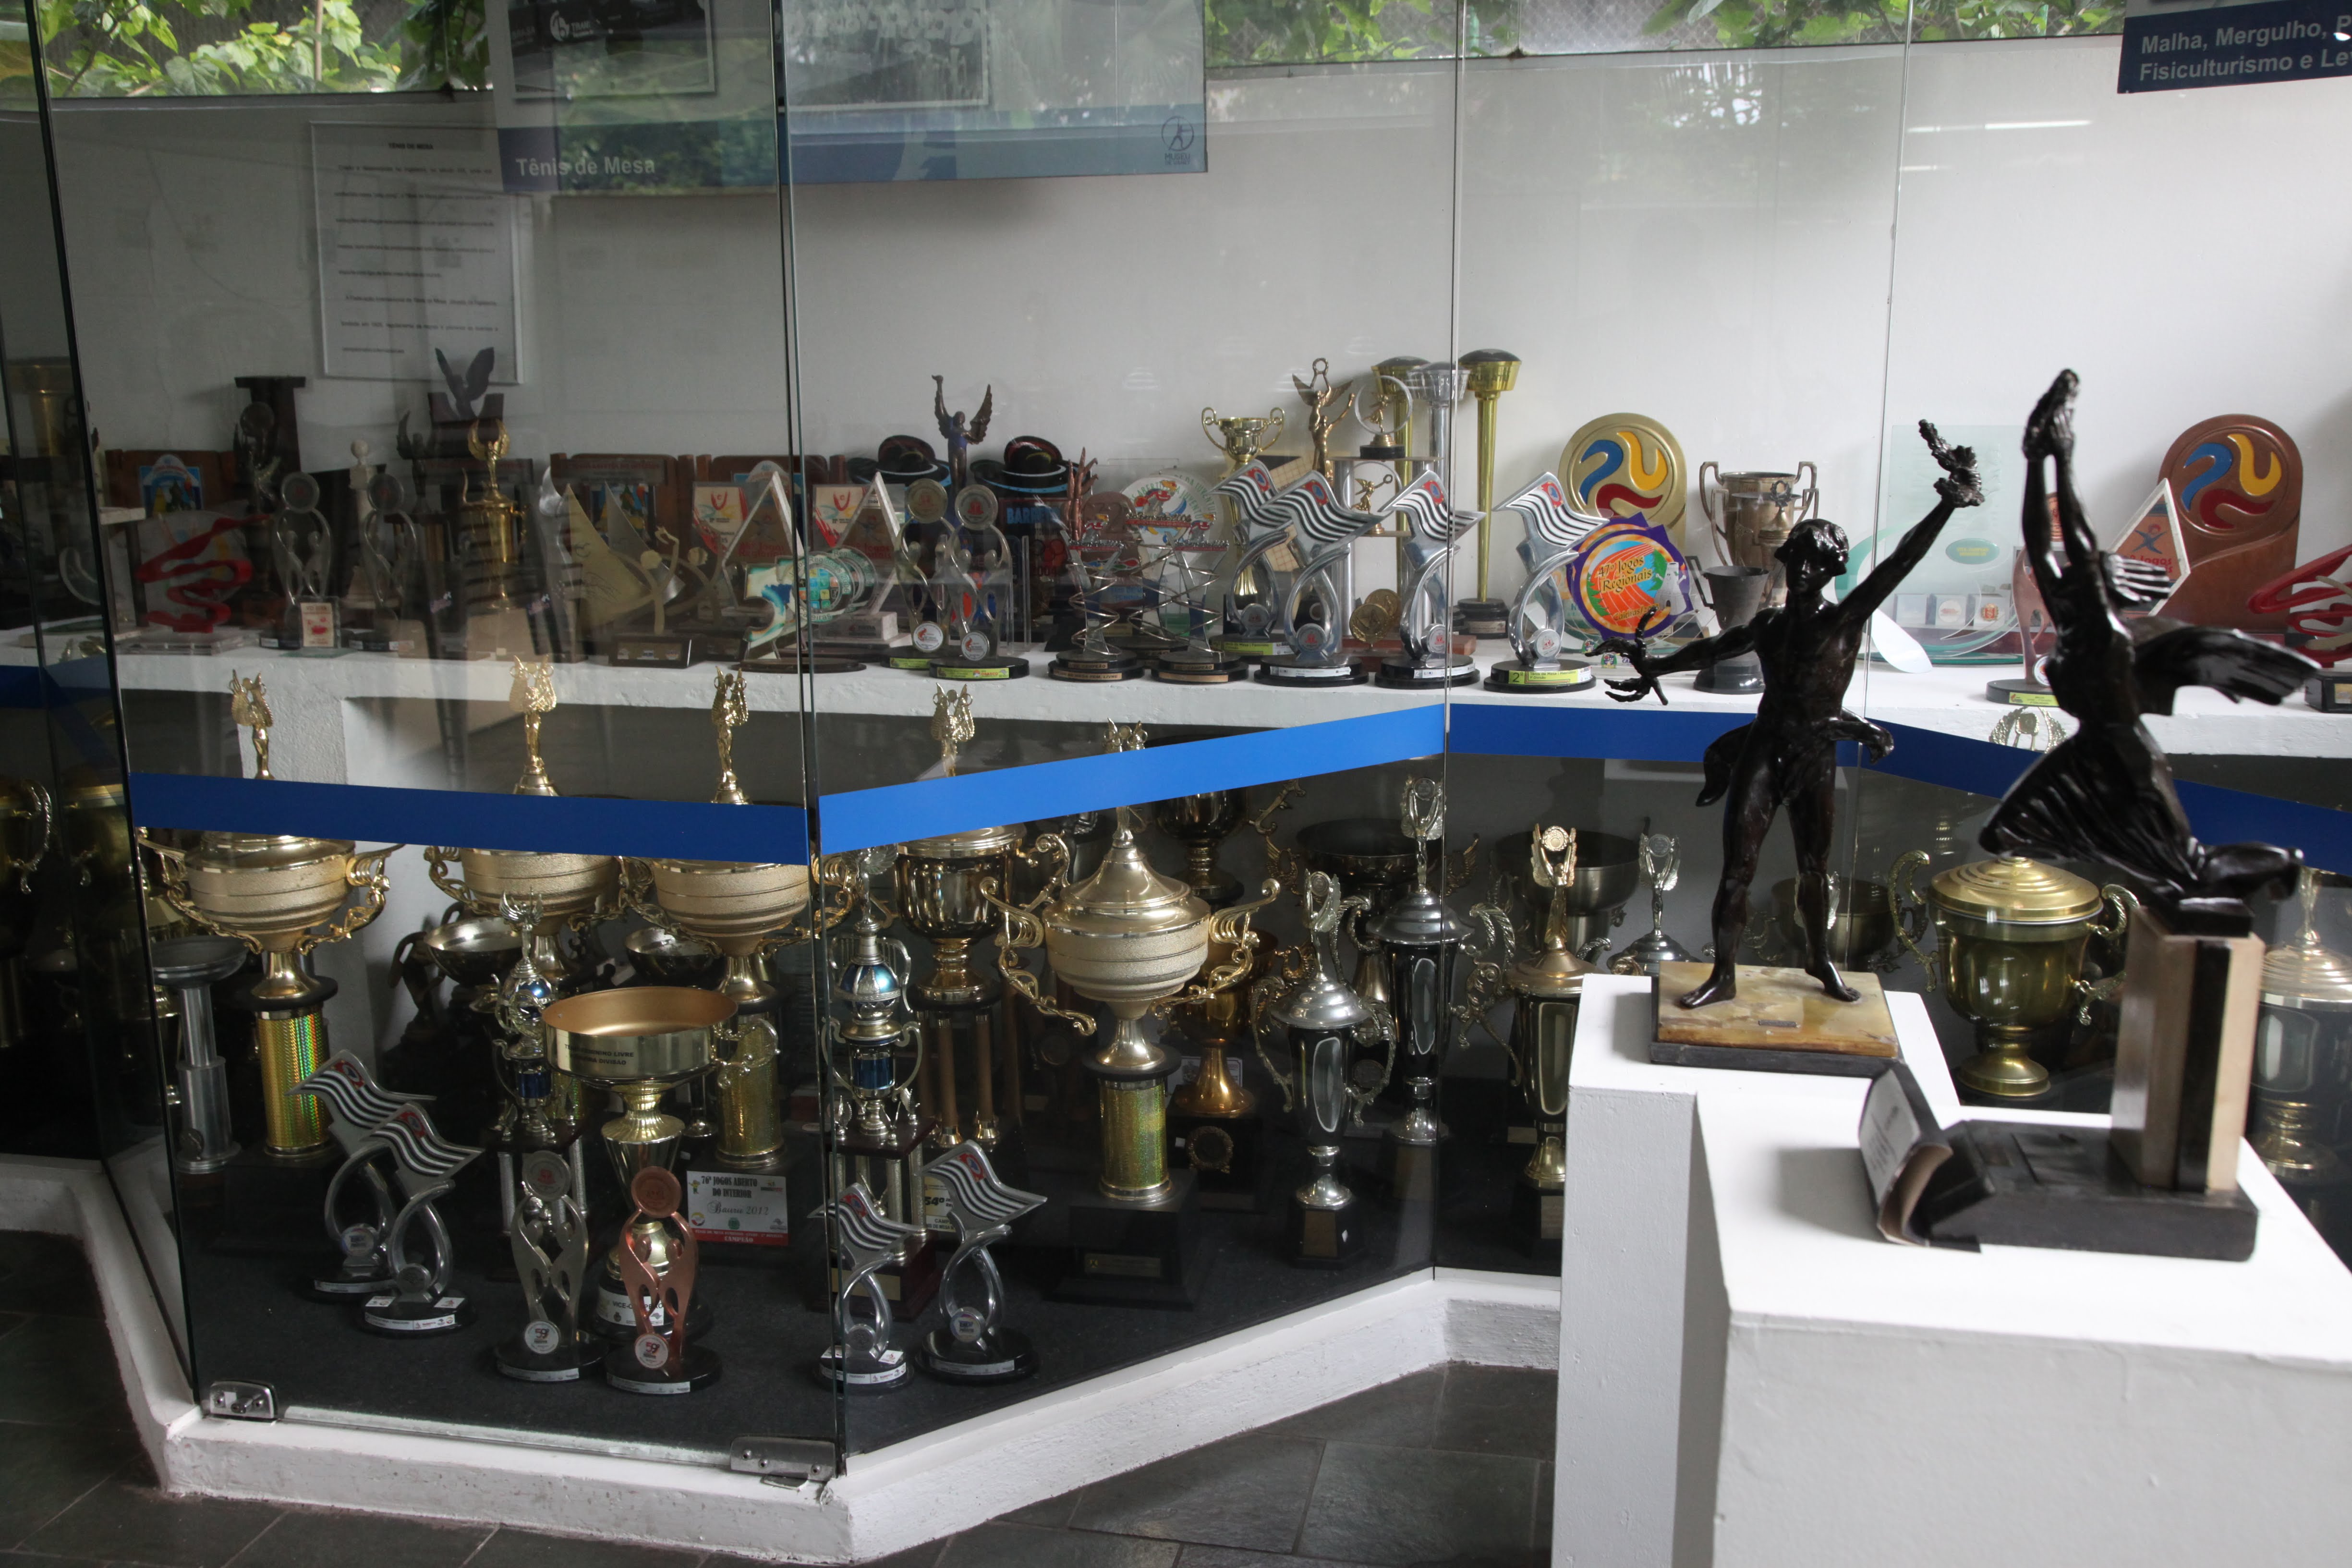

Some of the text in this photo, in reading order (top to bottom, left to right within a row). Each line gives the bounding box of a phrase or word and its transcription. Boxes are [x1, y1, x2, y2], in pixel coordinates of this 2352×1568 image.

[2142, 33, 2207, 54] Malha,
[2216, 20, 2327, 47] Mergulho,
[2140, 49, 2352, 81] Fisiculturismo e Le
[516, 157, 655, 177] Tênis de Mesa
[1618, 557, 1644, 573] Jogos
[1603, 569, 1651, 593] Regionais
[713, 1176, 732, 1186] JOGOS
[733, 1177, 758, 1187] ABERTO
[712, 1188, 721, 1196] DO
[723, 1188, 752, 1198] INTERIOR
[707, 1200, 744, 1214] Bauru
[612, 1300, 663, 1309] VICE-CPEO
